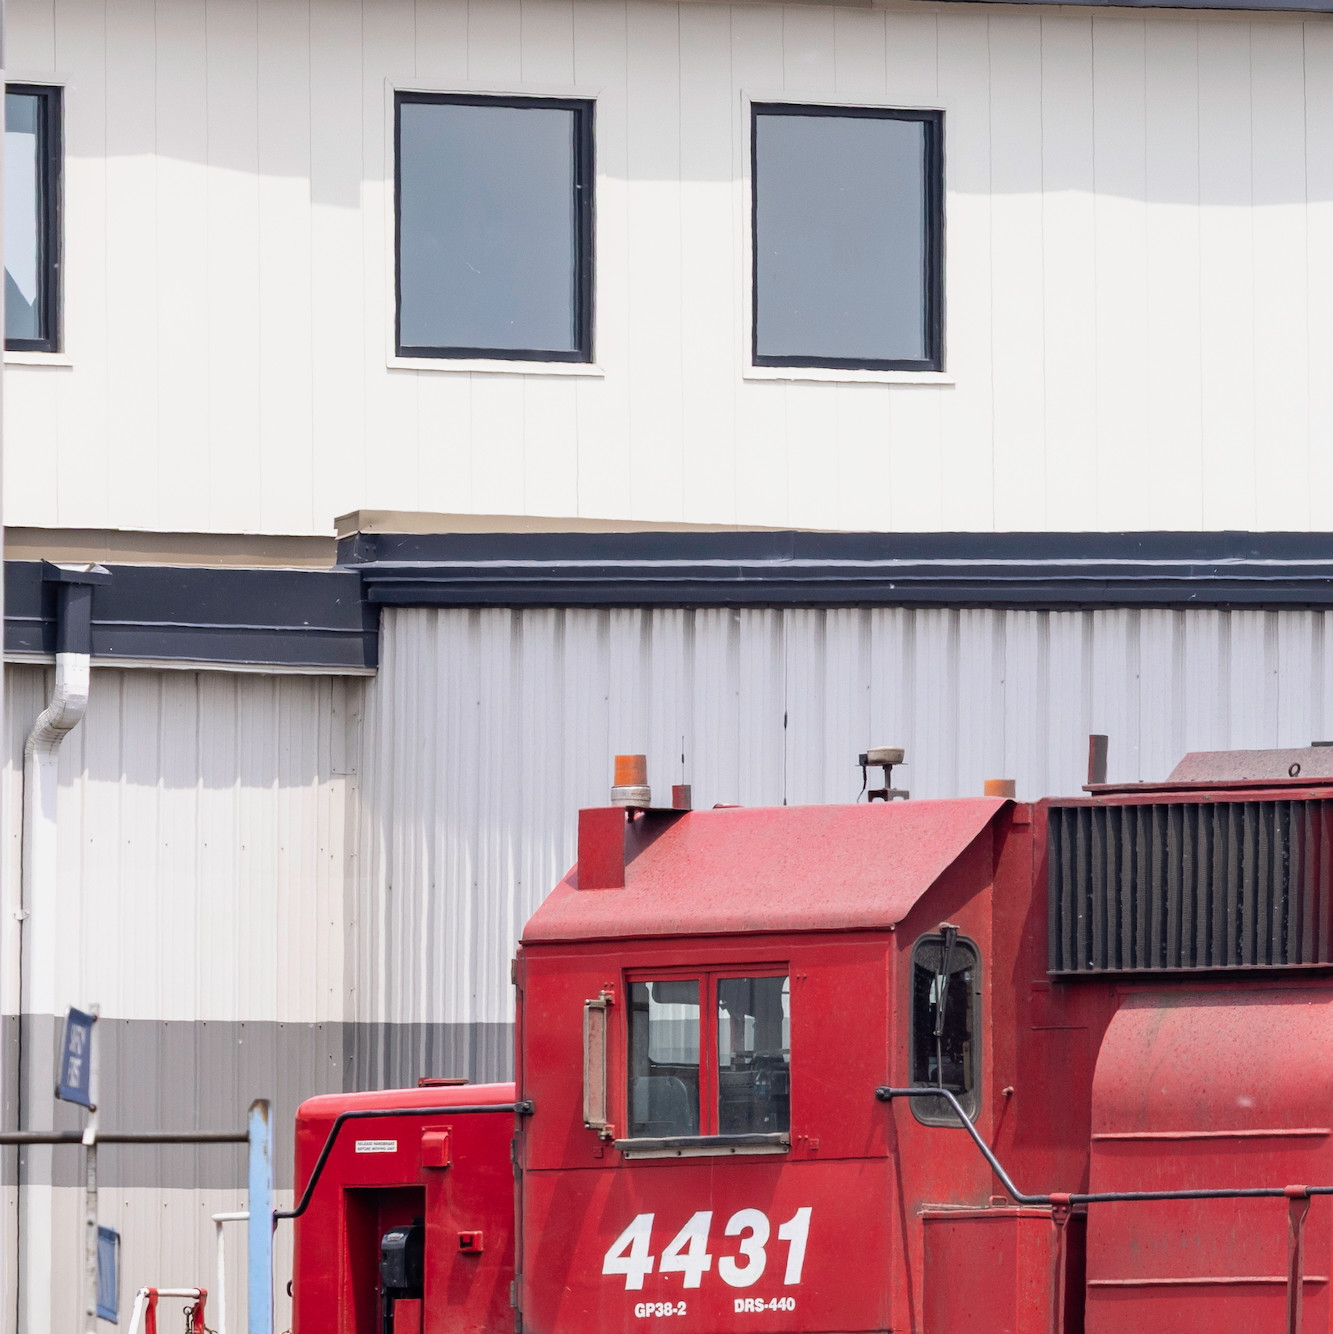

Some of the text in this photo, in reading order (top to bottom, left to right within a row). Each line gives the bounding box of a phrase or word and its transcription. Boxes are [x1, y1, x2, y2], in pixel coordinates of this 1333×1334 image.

[602, 1206, 813, 1291] 4431
[634, 1297, 796, 1318] GP38-2 DRS-440
